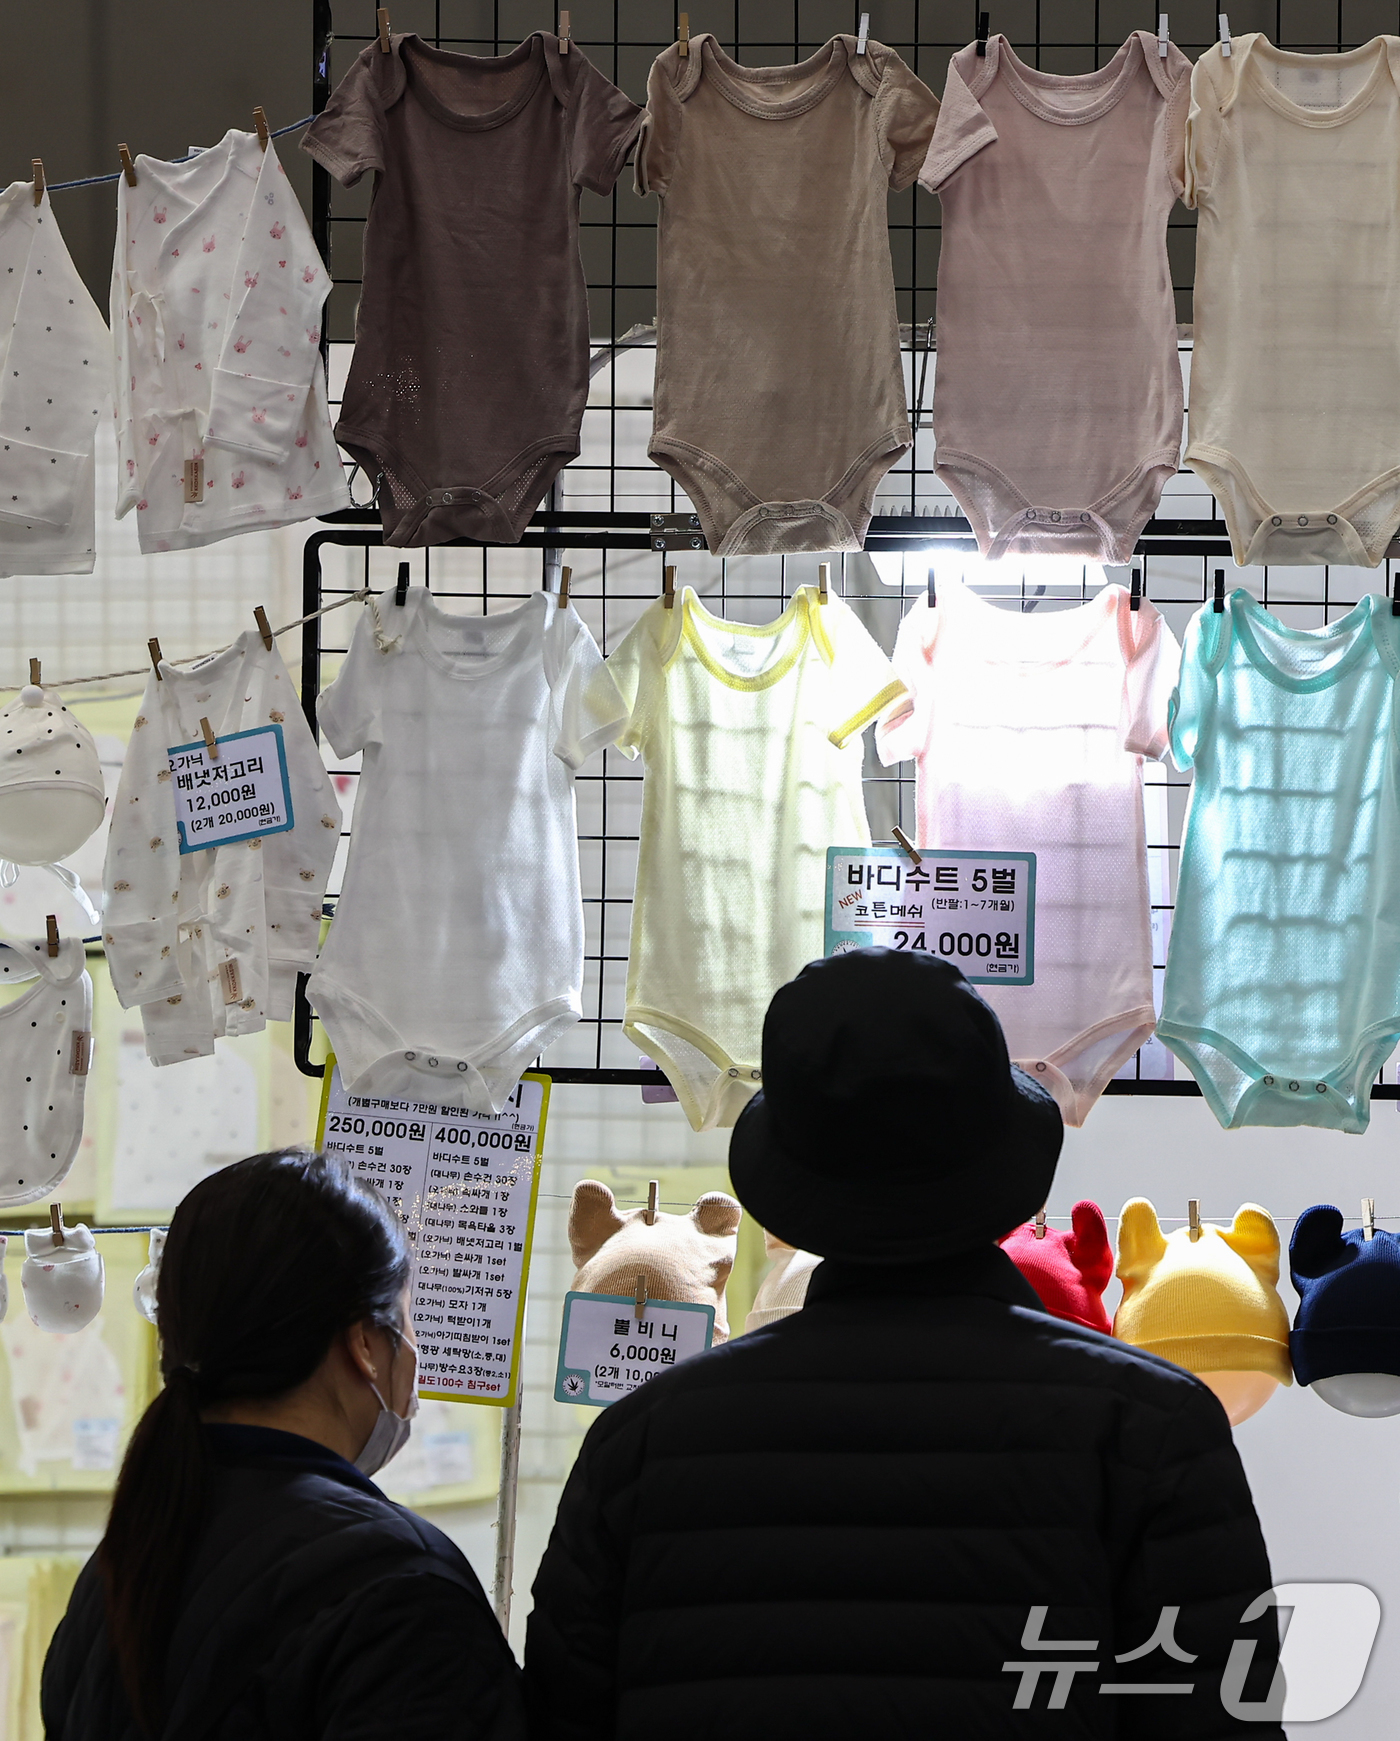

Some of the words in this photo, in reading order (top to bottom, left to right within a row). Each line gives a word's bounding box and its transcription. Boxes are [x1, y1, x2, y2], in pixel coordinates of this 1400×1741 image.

[177, 756, 264, 790] 배냇저고리
[186, 783, 257, 813] 12,000원
[190, 816, 214, 833] (2개
[218, 802, 276, 826] 20,000원)
[847, 864, 960, 892] 바디수트
[971, 867, 1016, 895] 5벌
[838, 889, 864, 909] NEW
[854, 901, 924, 919] 코튼메쉬
[412, 1103, 438, 1115] 7만원
[329, 1116, 426, 1142] 250,000원
[434, 1126, 532, 1152] 400,000원
[327, 1141, 364, 1154] 바디수트
[368, 1146, 384, 1156] 5벌
[432, 1152, 470, 1165] 바디수트
[474, 1156, 490, 1167] 5벌
[358, 1160, 386, 1173] 손수건
[390, 1164, 412, 1175] 30장
[430, 1169, 460, 1181] (대나무)
[464, 1171, 492, 1184] 손수건
[388, 1180, 404, 1190] 1장
[494, 1192, 510, 1202] 1장
[492, 1208, 508, 1218] 1장
[424, 1217, 454, 1229] (대나무)
[499, 1224, 516, 1235] 3장
[506, 1242, 523, 1252] 1벌
[454, 1252, 483, 1264] 손싸개
[486, 1256, 506, 1266] 1set
[452, 1268, 481, 1280] 발싸개
[484, 1272, 506, 1282] 1set
[496, 1289, 512, 1300] 5장
[415, 1298, 446, 1309] (오가닉)
[448, 1300, 468, 1311] 모자
[471, 1302, 487, 1312] 1개
[413, 1313, 444, 1324] (오가닉)
[447, 1315, 492, 1328] 턱받이1개
[414, 1330, 489, 1345] 오가닉)아기띠침받이
[492, 1336, 511, 1347] 1set
[417, 1344, 440, 1356] 형광
[610, 1343, 677, 1365] 6,000원
[594, 1364, 620, 1380] (2개
[418, 1374, 464, 1388] 밀도100수
[467, 1379, 501, 1392] 침구set
